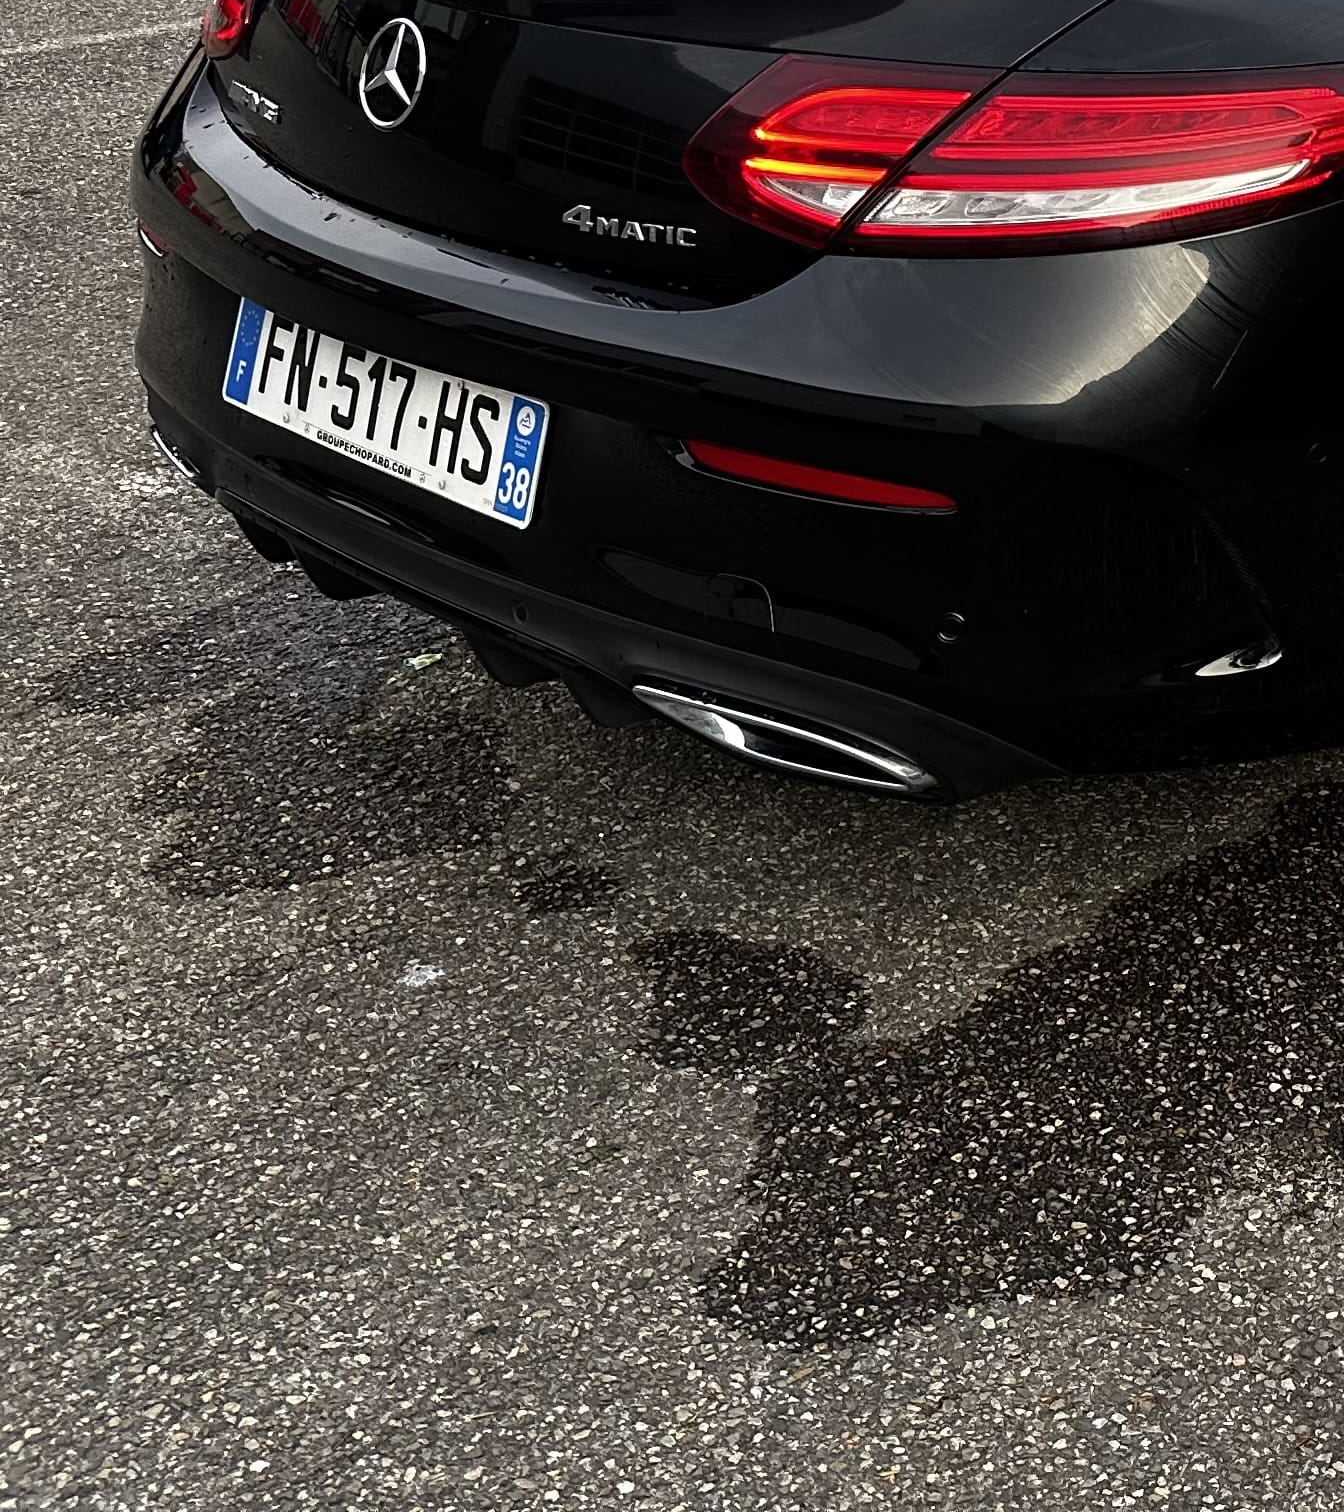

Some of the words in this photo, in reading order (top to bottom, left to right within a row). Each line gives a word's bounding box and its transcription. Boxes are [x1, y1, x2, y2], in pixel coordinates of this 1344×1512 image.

[562, 204, 697, 247] 4MATIC
[236, 360, 247, 382] F
[316, 428, 412, 479] GROUPECHOPARD.COM
[498, 461, 531, 510] 38
